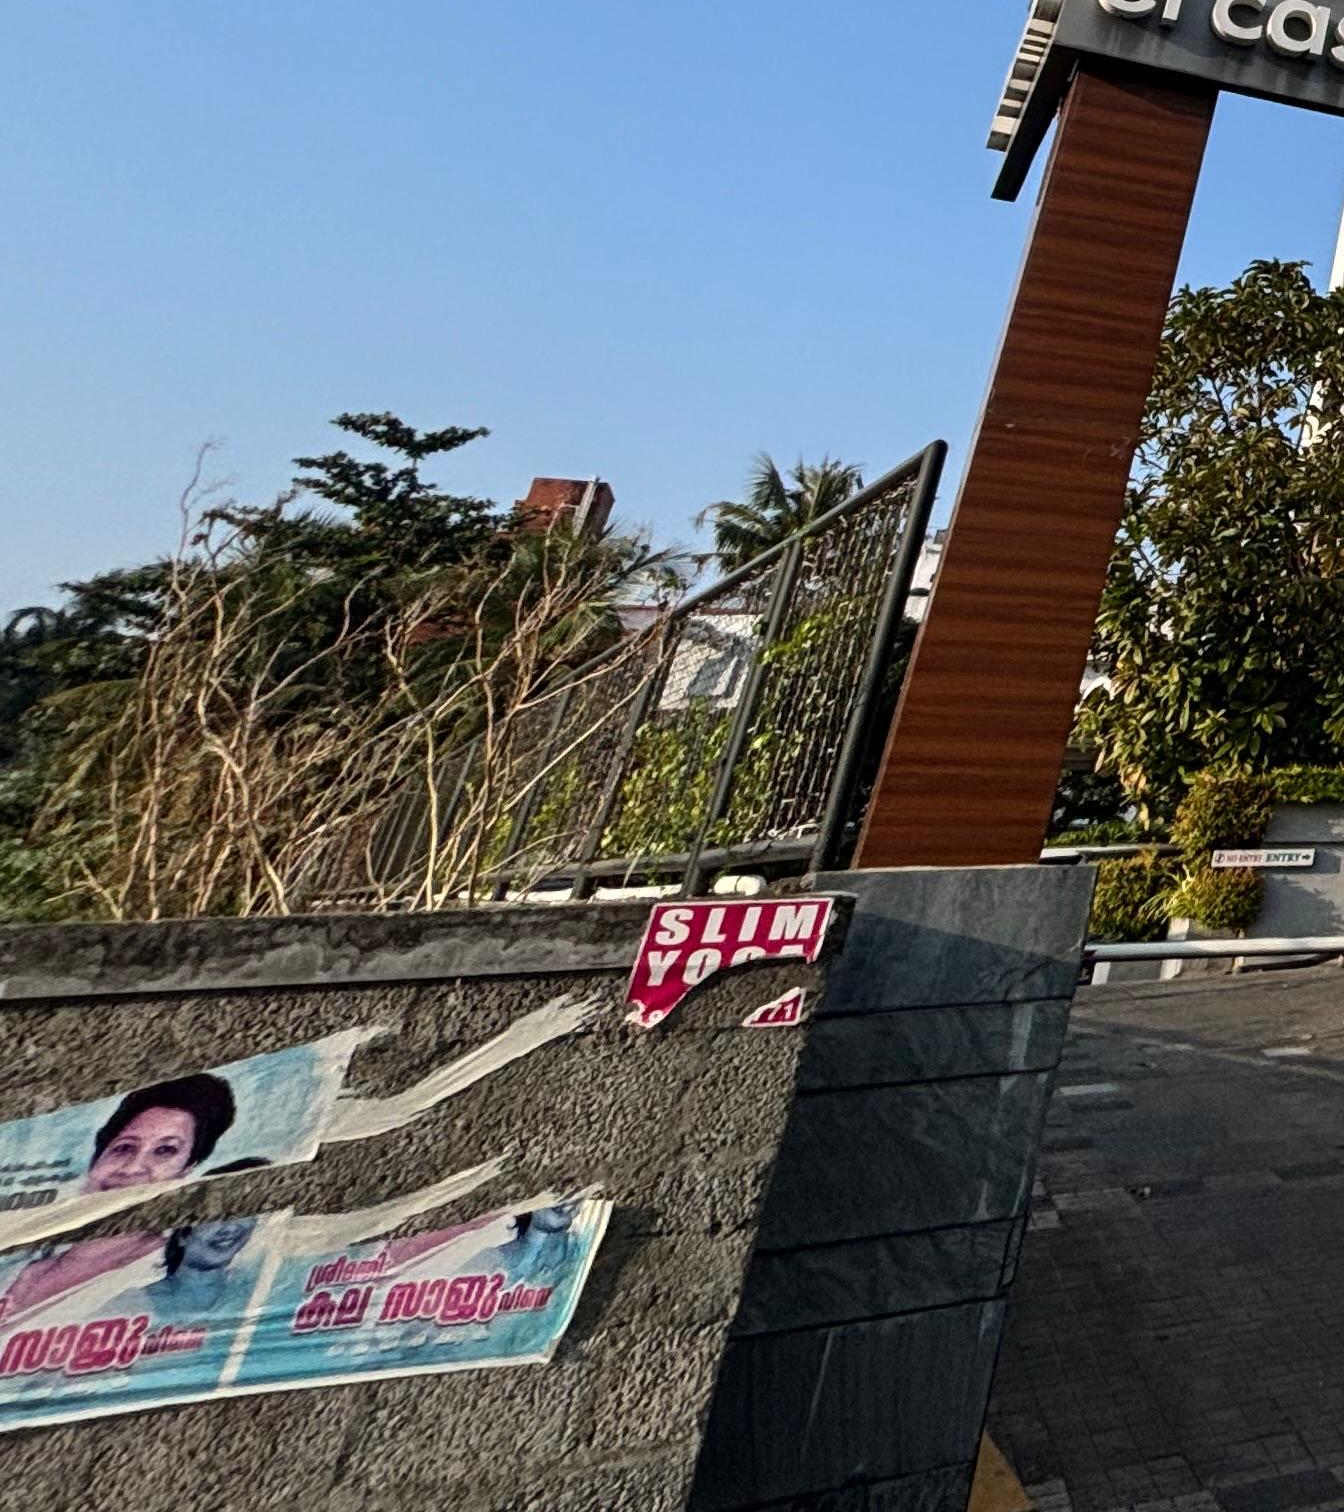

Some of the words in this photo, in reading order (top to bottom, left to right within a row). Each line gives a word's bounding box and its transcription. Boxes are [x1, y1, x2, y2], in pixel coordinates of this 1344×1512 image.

[1265, 852, 1301, 863] ENTRY
[655, 903, 820, 946] SLIM
[647, 944, 804, 987] YO
